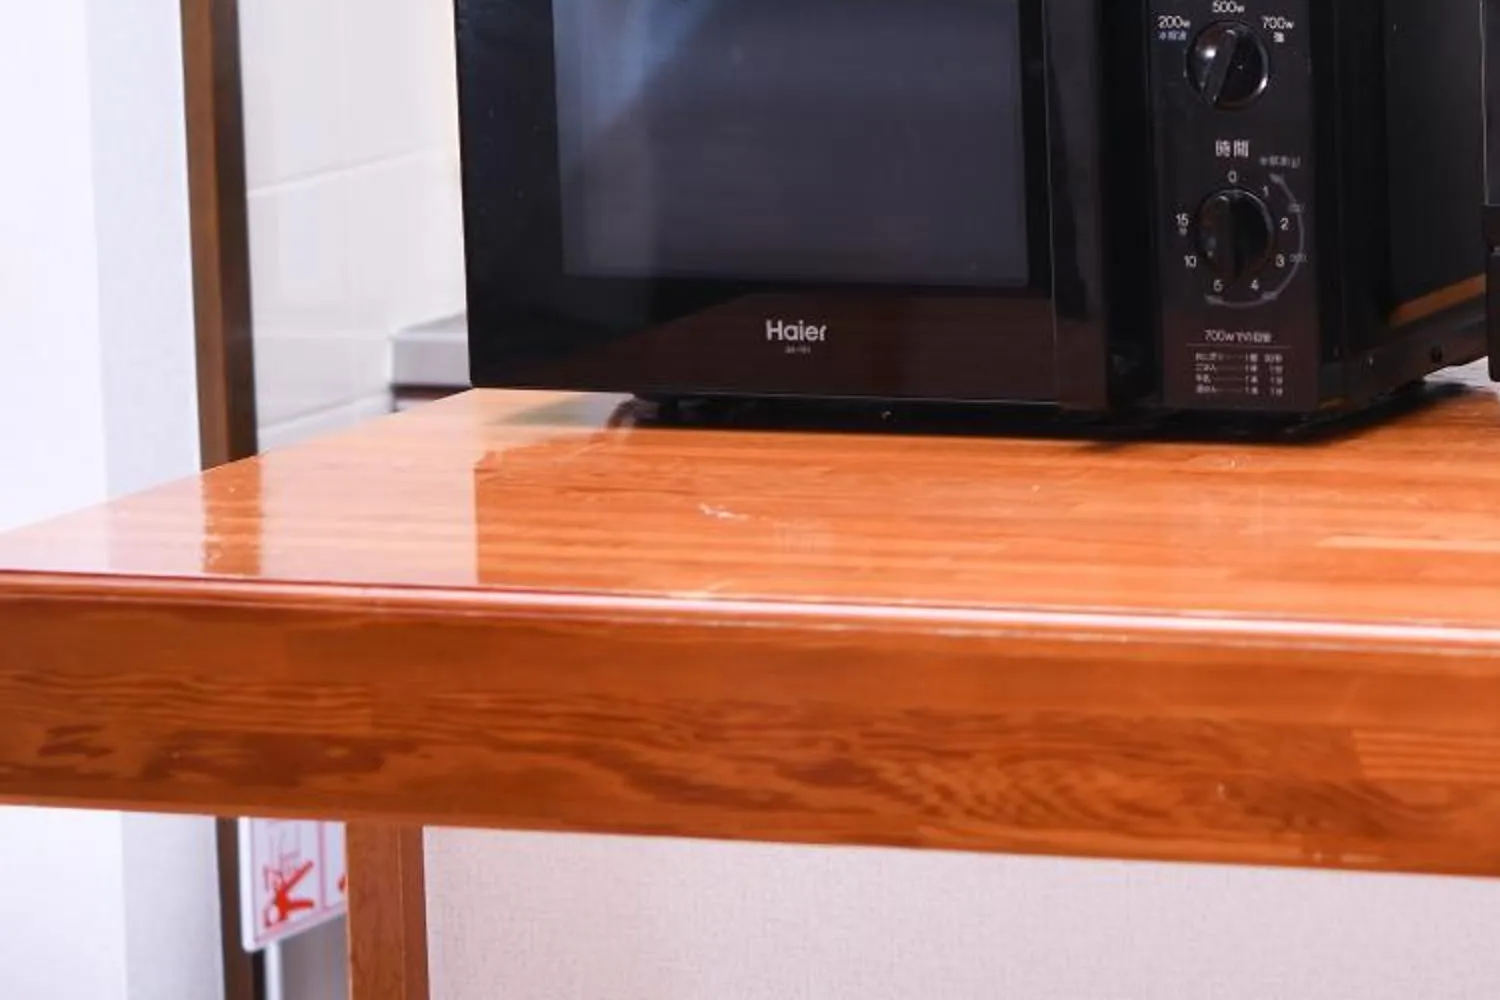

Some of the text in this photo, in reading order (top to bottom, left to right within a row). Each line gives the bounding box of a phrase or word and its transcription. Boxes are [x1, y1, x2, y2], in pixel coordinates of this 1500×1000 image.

[1215, 140, 1249, 158] 時間
[1227, 170, 1238, 183] 0
[1262, 185, 1269, 197] 1
[1175, 213, 1189, 226] 15
[1280, 217, 1289, 230] 2
[1184, 255, 1197, 268] 10
[1275, 254, 1285, 268] 3
[1250, 278, 1259, 290] 4
[765, 319, 828, 341] Haier
